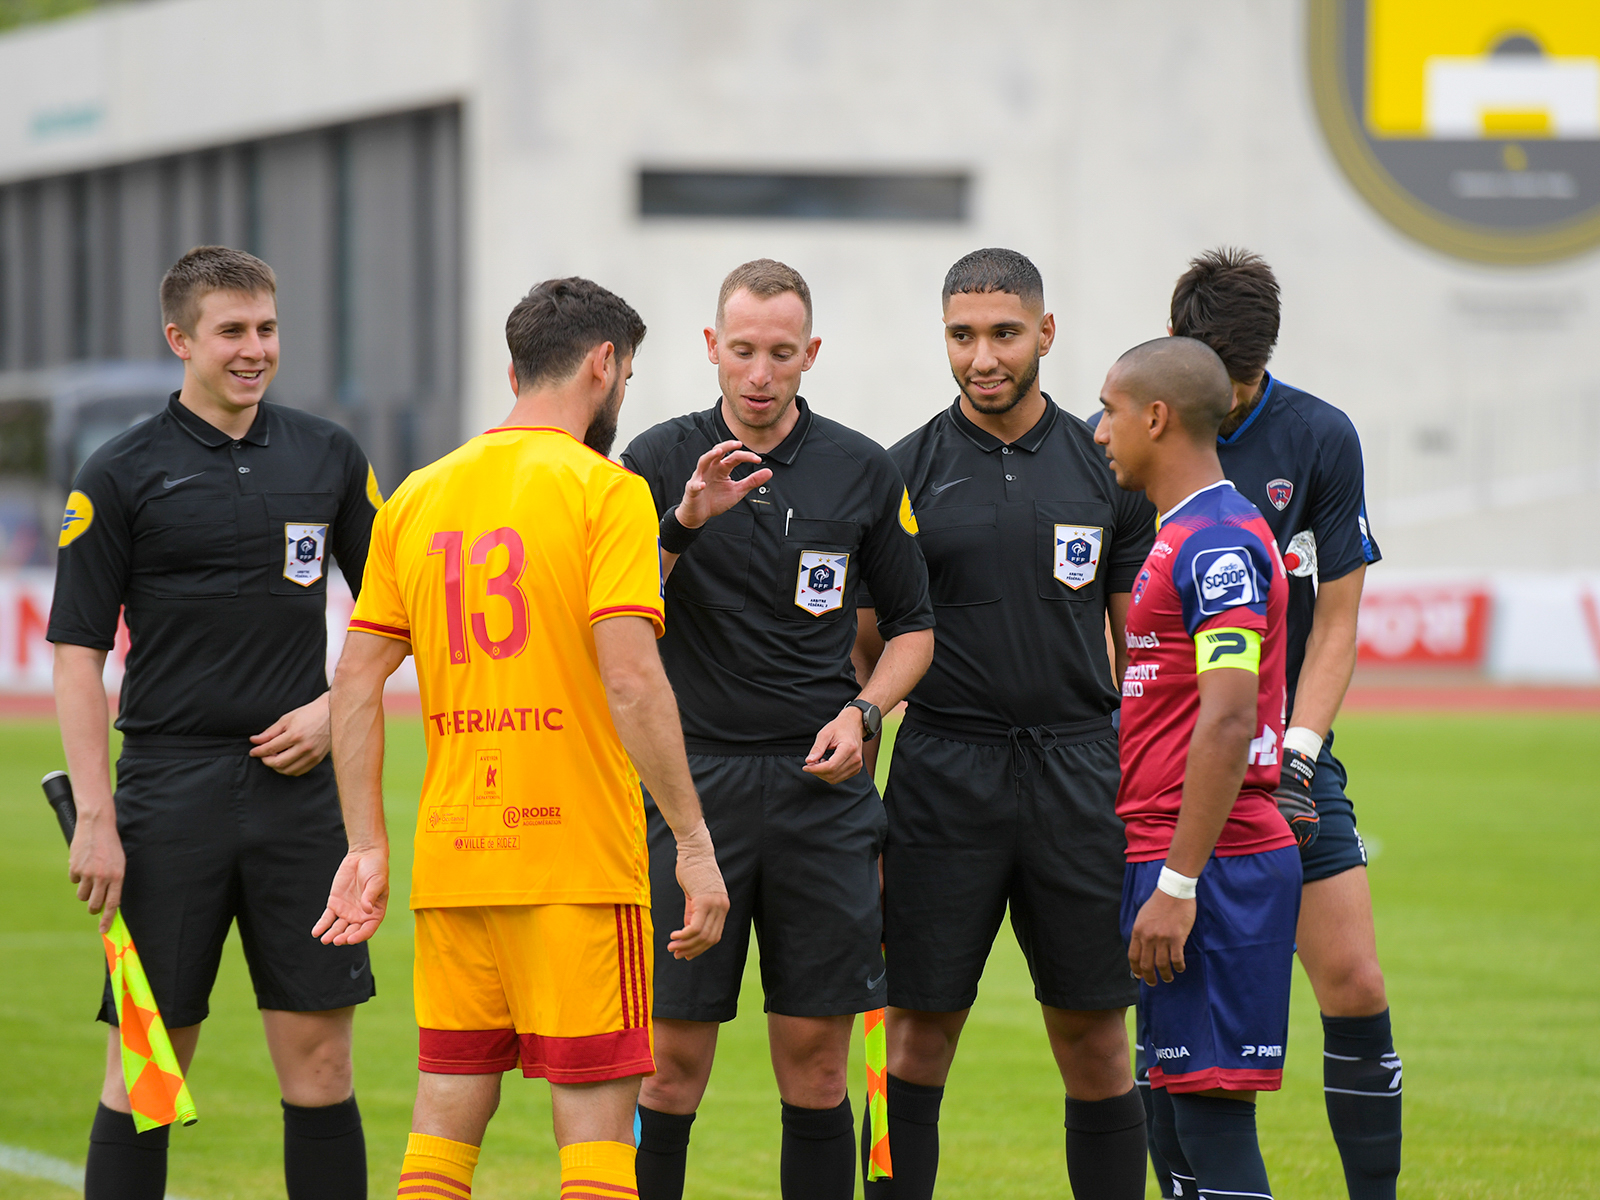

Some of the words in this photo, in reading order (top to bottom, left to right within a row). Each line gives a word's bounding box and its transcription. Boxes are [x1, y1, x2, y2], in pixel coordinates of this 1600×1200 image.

[1220, 563, 1239, 571] radio
[1205, 569, 1246, 590] SCOOP
[427, 526, 531, 665] 13
[522, 807, 561, 817] RODEZ
[464, 838, 485, 849] VILLE
[488, 839, 494, 848] de
